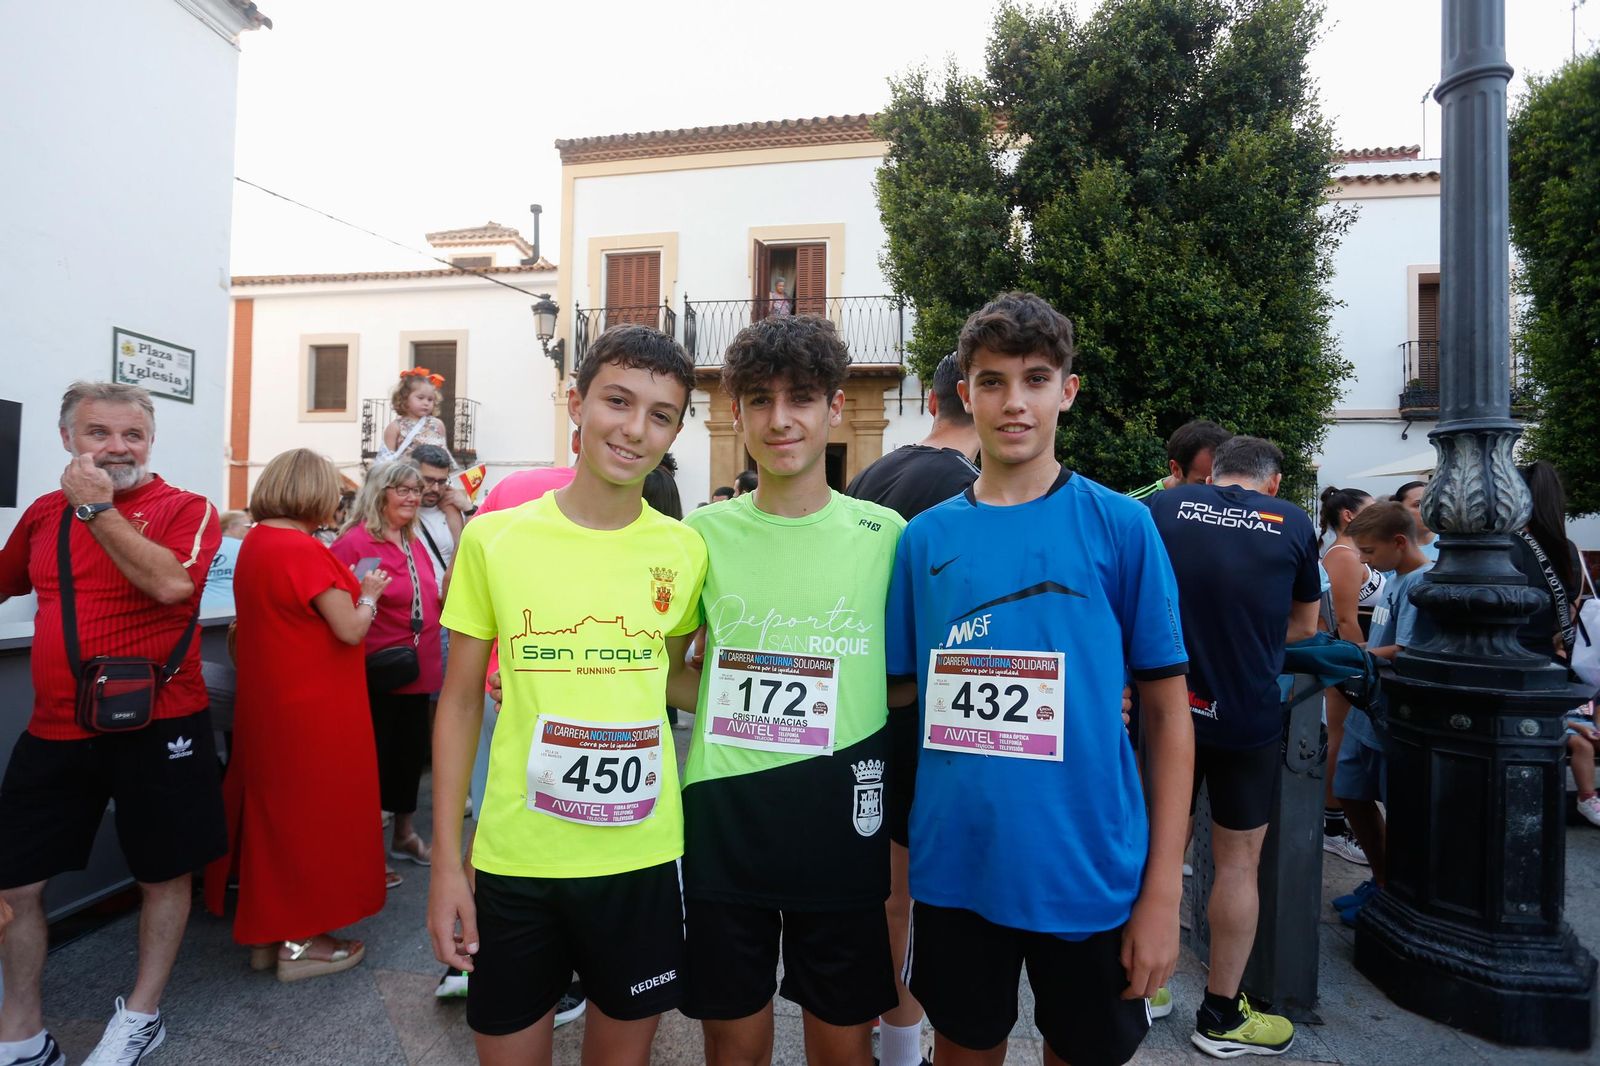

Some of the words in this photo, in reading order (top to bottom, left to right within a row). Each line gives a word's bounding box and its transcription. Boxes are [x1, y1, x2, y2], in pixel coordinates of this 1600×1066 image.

[138, 343, 172, 360] Plaza
[146, 358, 156, 368] de
[158, 360, 165, 368] la
[129, 364, 182, 385] Iglesia
[1180, 501, 1261, 520] POLICIA
[1177, 510, 1281, 534] NACIONAL
[709, 594, 872, 650] Deportes
[946, 614, 992, 648] MVSF
[522, 645, 574, 660] San
[586, 648, 652, 662] roque
[728, 652, 754, 664] CARRERA
[754, 654, 793, 667] NOCTURNA
[794, 658, 832, 671] SOLIDARIA
[576, 667, 616, 675] RUNNING
[943, 656, 970, 666] CARRERA
[970, 657, 1011, 668] NOCTURNA
[1012, 658, 1056, 672] SOLIDARIA
[738, 677, 807, 717] 172
[952, 682, 1028, 723] 432
[727, 720, 774, 736] AVATEL
[732, 712, 770, 724] CRISTIAN
[772, 717, 808, 728] MACIAS
[554, 725, 590, 740] CARRERA
[590, 730, 632, 742] NOCTURNA
[944, 728, 994, 744] AVATEL
[168, 750, 192, 760] adidas
[562, 755, 642, 794] 450
[552, 800, 608, 817] AVATEL
